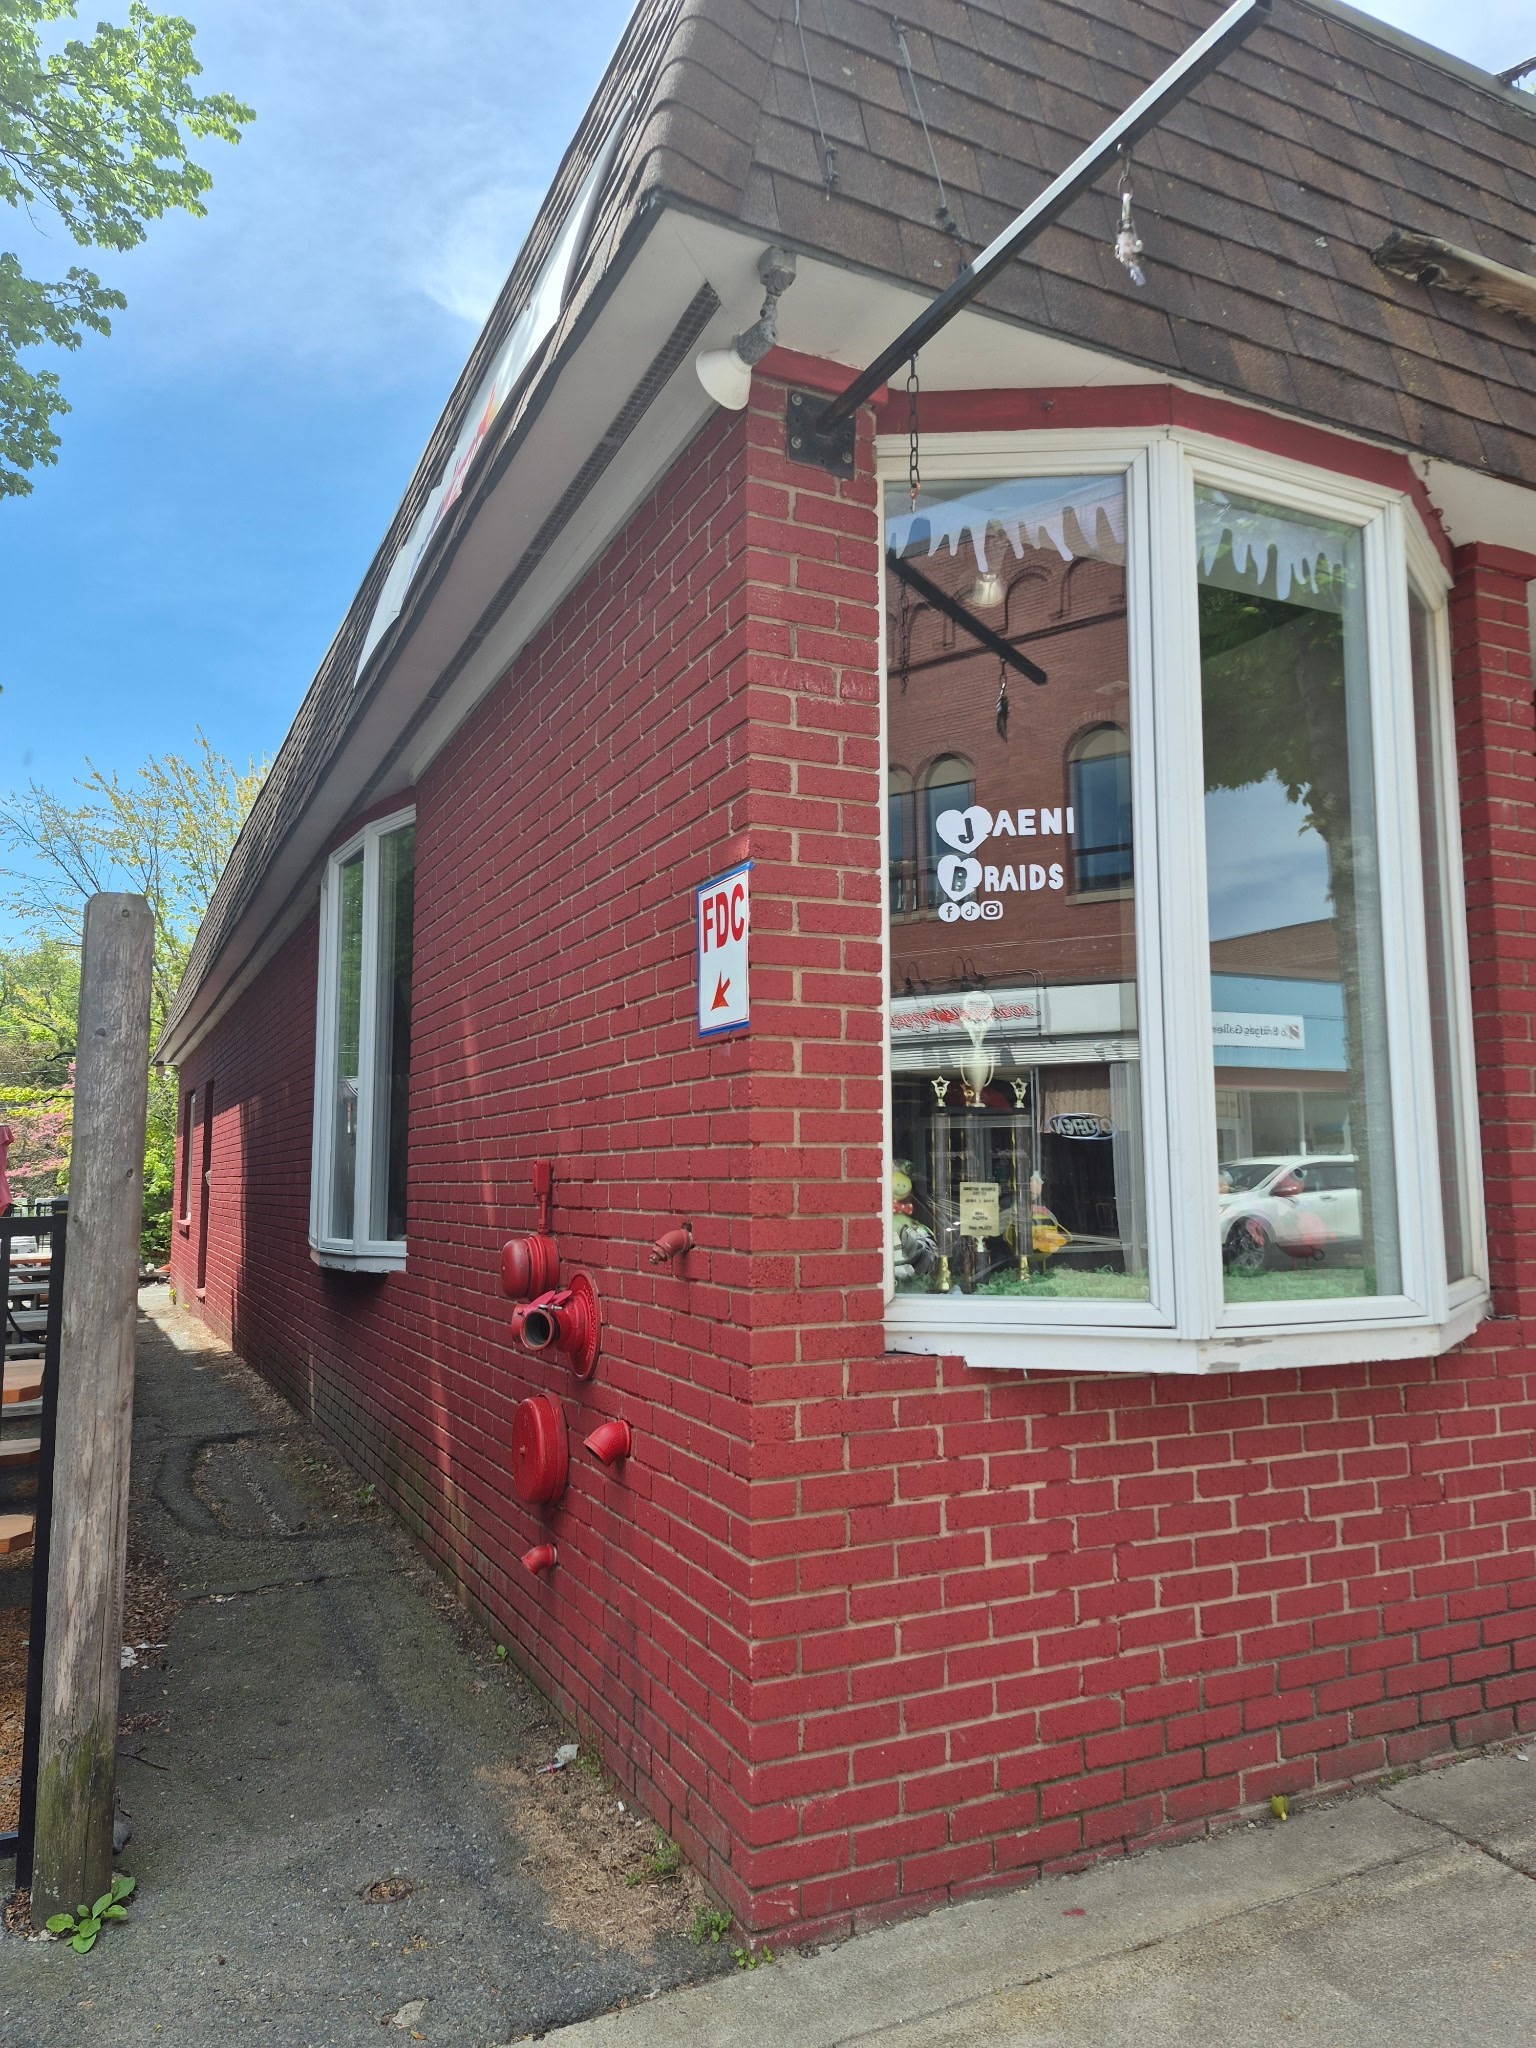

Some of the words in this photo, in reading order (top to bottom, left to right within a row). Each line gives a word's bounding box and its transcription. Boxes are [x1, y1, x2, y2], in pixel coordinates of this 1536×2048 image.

[957, 806, 1075, 844] JAENI
[950, 862, 1064, 893] BRAIDS
[702, 883, 745, 954] FDC
